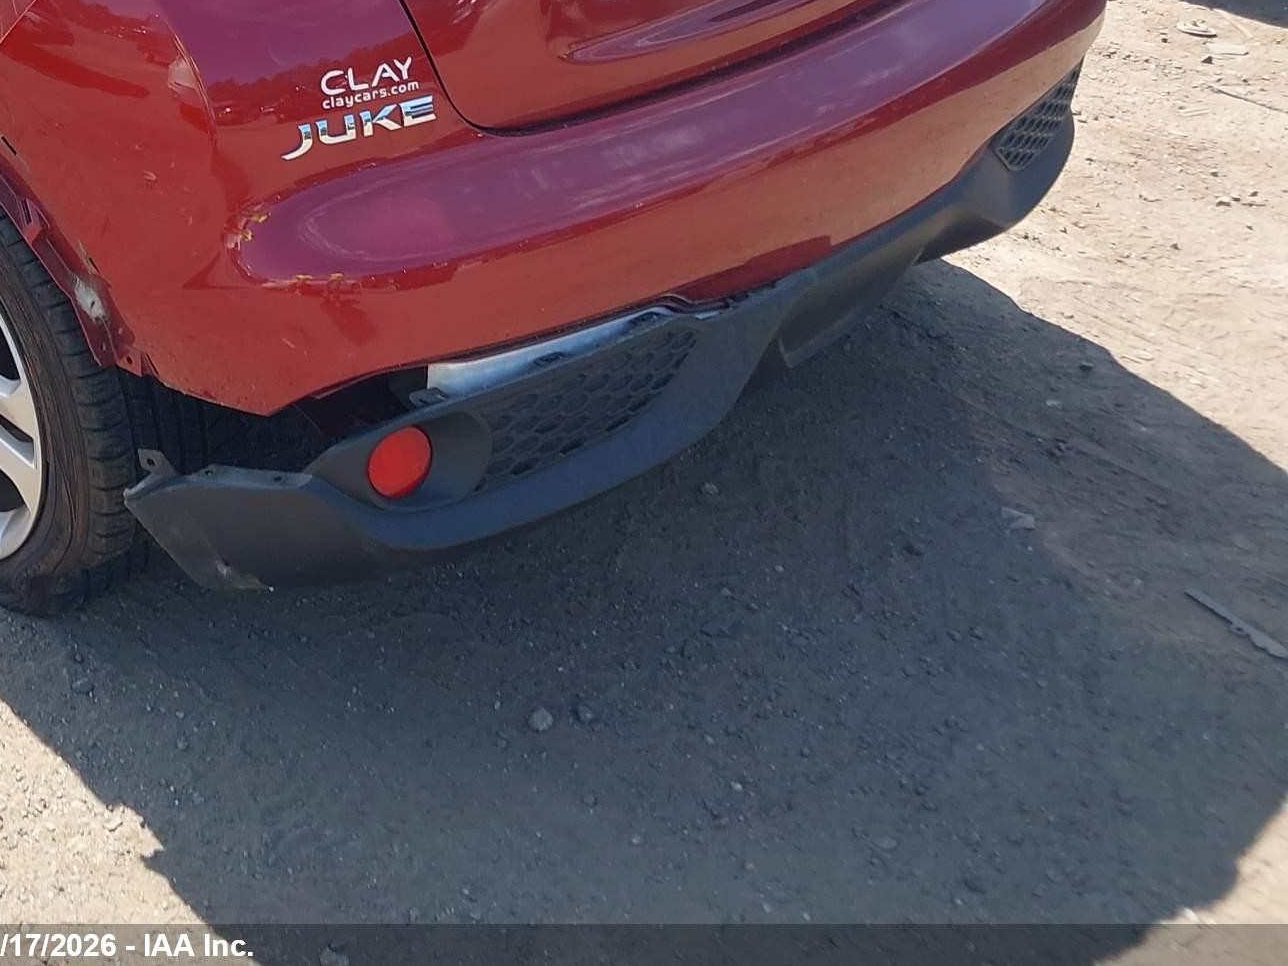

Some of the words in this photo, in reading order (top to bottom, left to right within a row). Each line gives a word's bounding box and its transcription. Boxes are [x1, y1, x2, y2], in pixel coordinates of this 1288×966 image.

[320, 56, 412, 96] CLAY
[322, 81, 420, 110] claycars.com
[280, 95, 437, 161] JUKE
